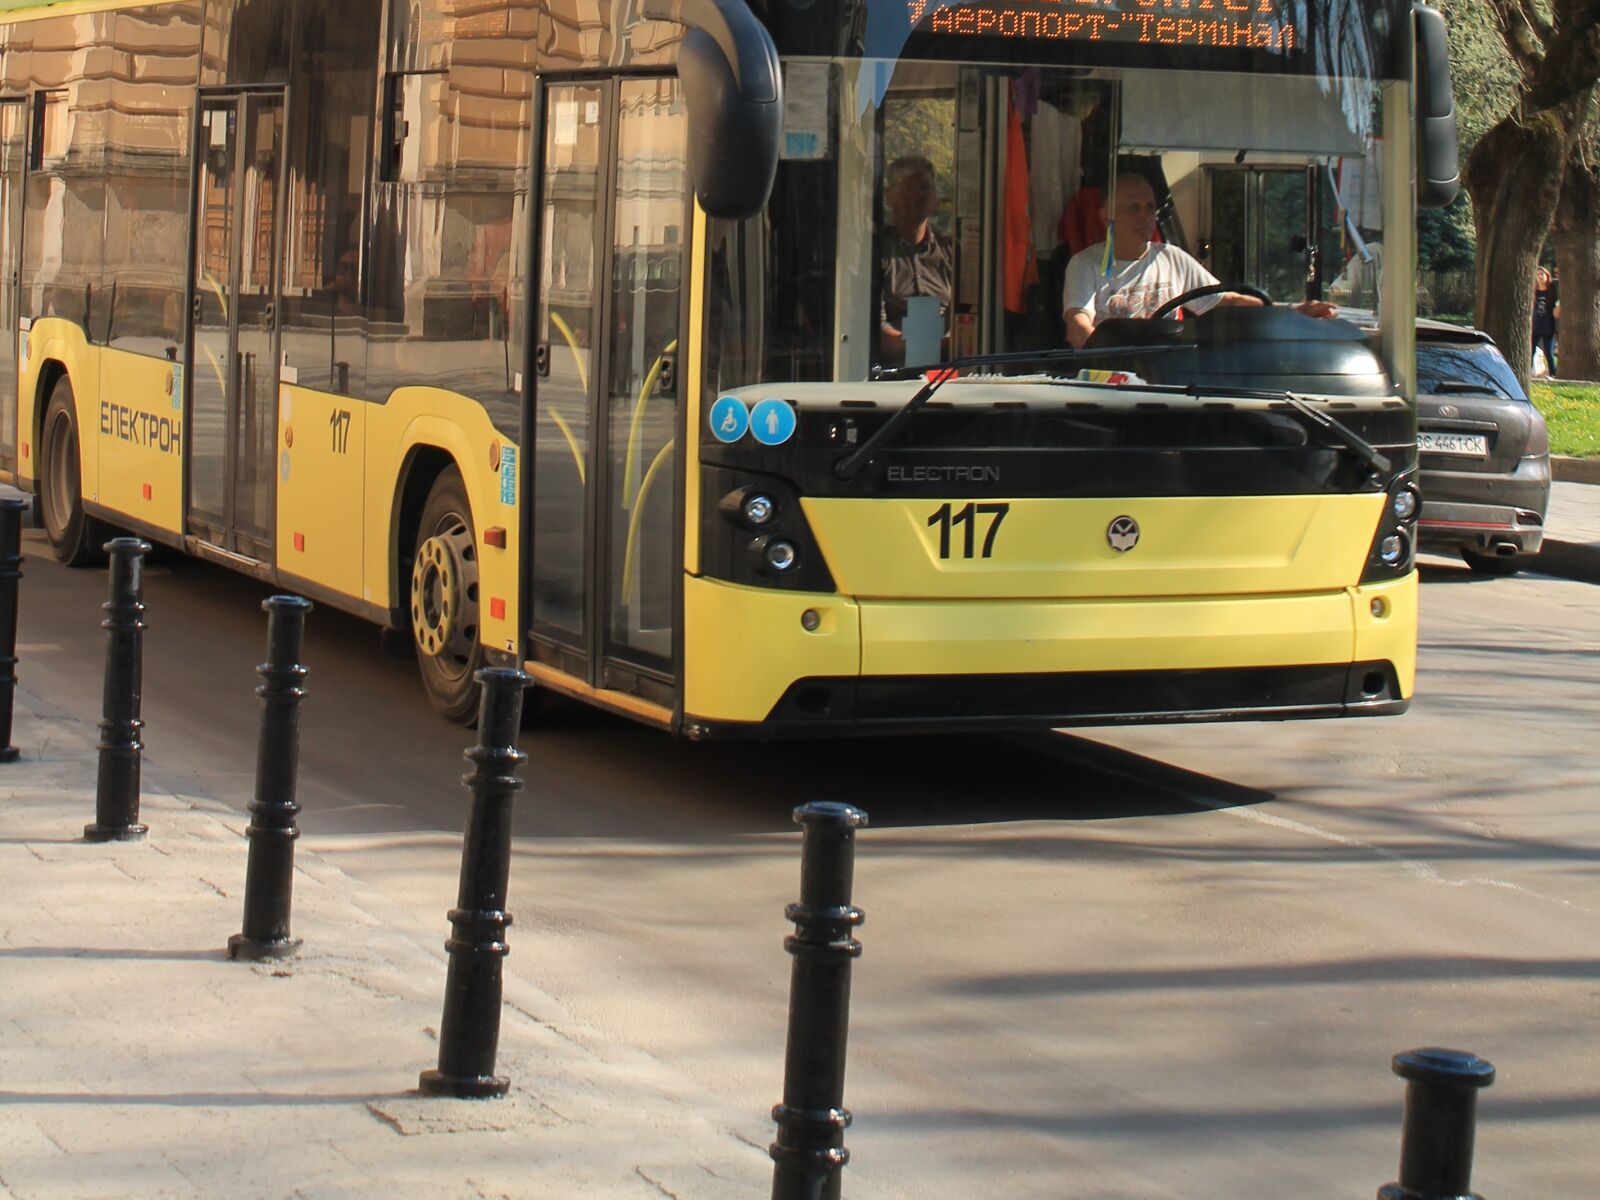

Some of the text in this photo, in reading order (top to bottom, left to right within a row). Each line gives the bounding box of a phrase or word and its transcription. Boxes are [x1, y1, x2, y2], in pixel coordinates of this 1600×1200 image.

[330, 408, 351, 454] 117
[887, 465, 1000, 481] ELECTRON
[927, 502, 1010, 559] 117
